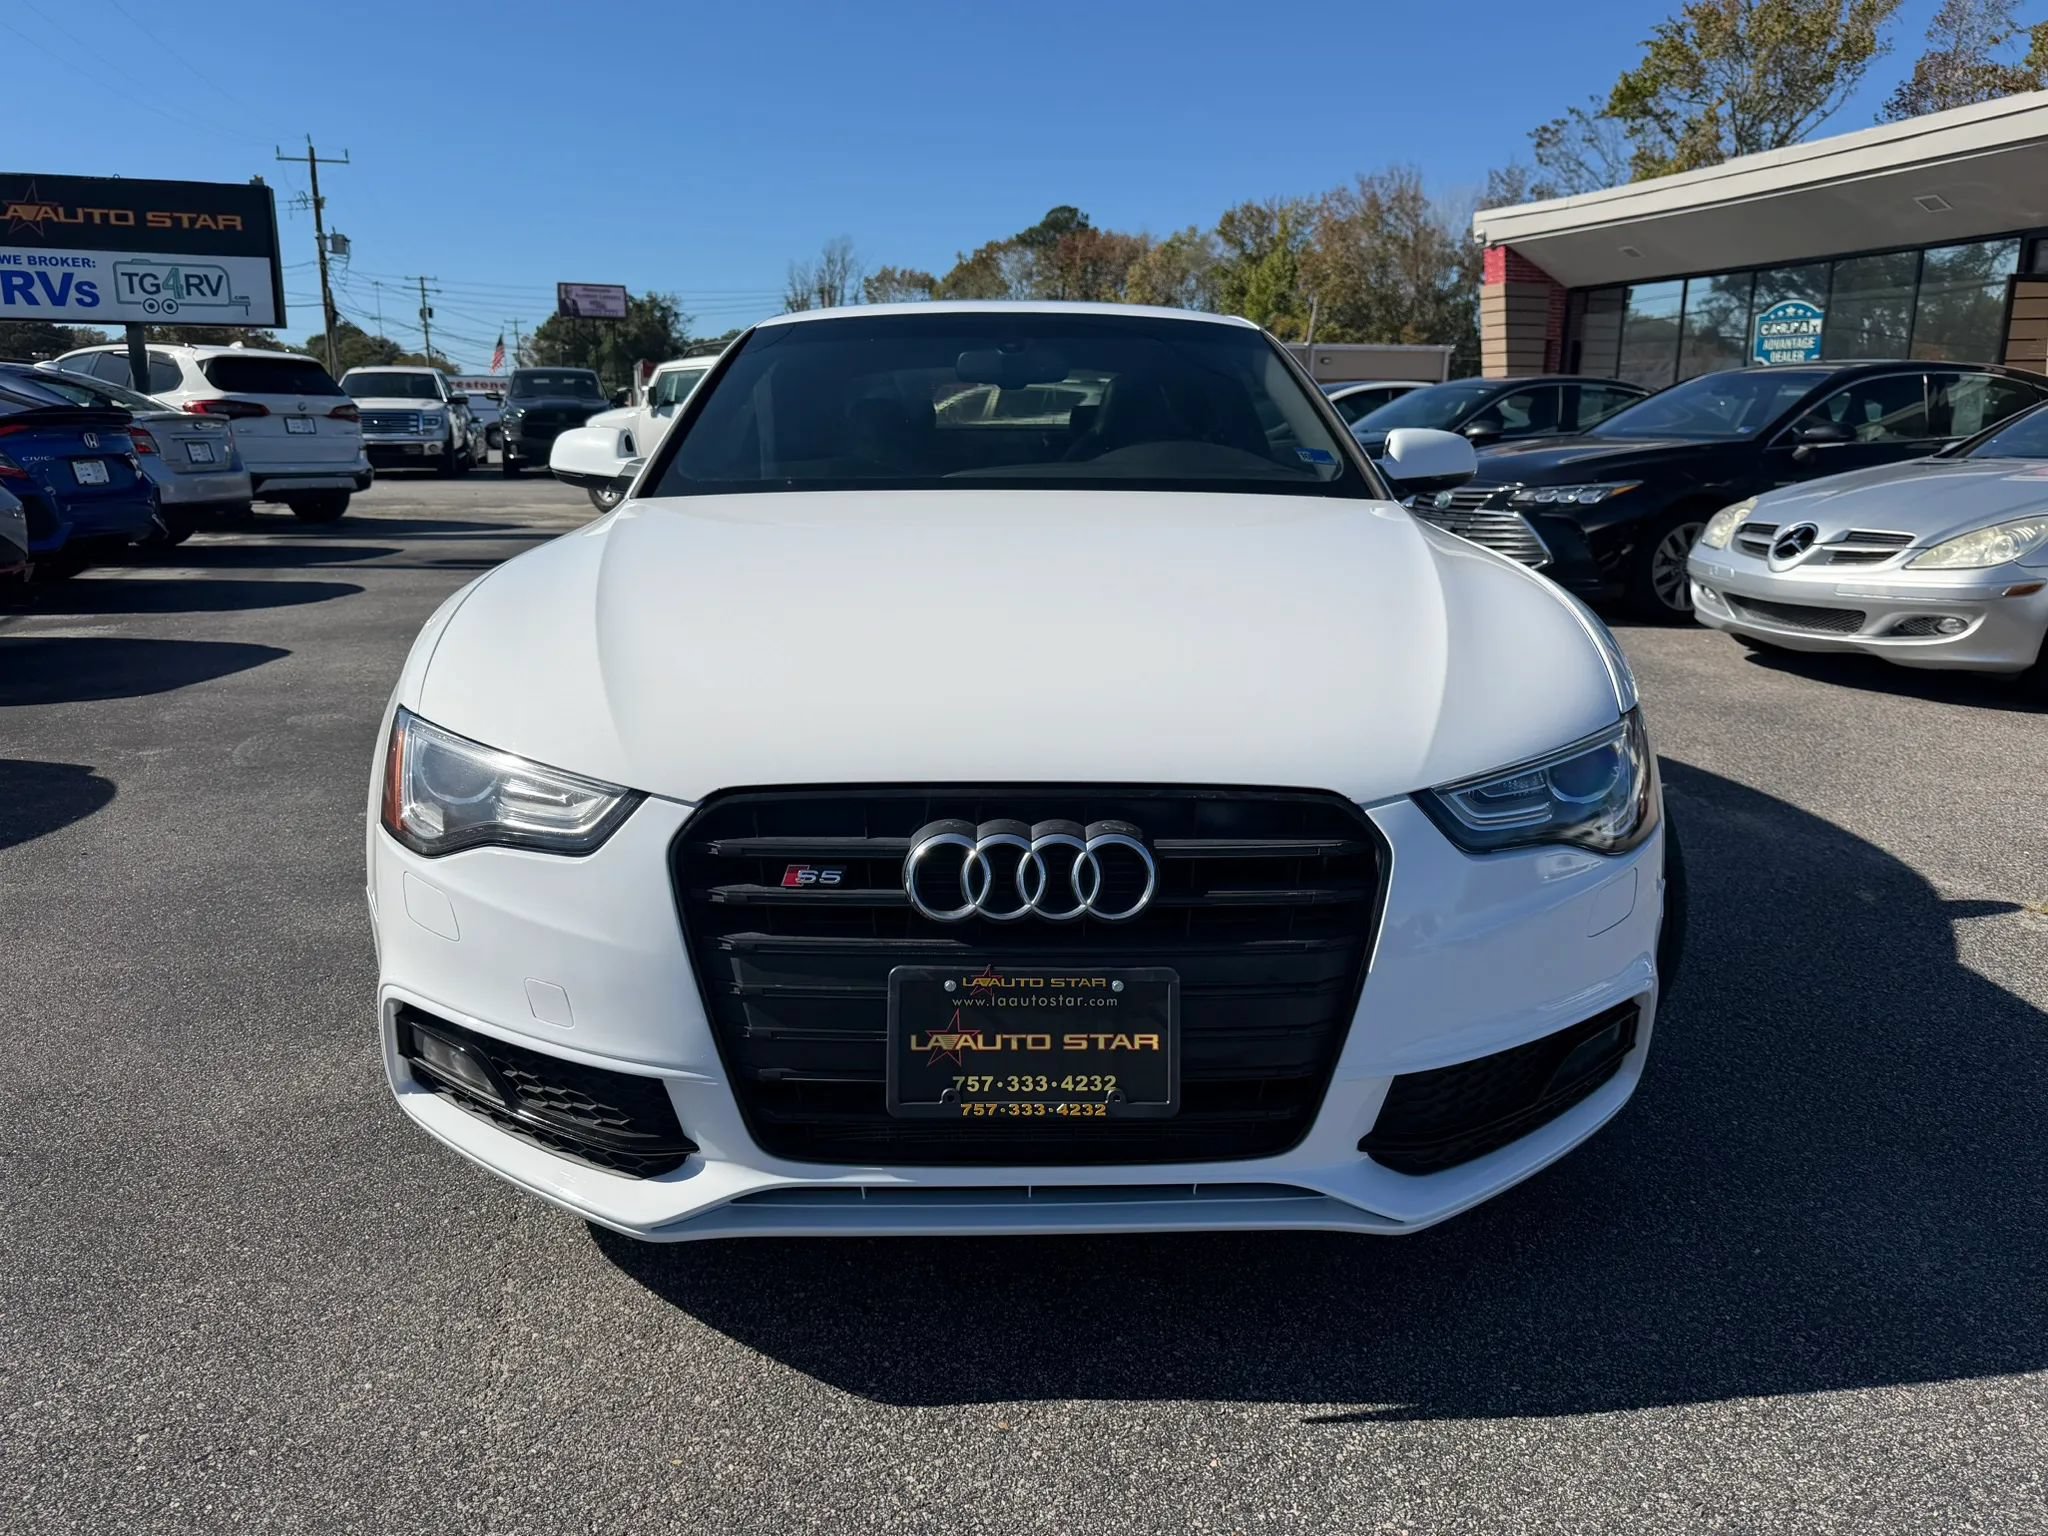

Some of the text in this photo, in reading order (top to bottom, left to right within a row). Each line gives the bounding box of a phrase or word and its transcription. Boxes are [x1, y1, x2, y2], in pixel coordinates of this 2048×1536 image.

[145, 211, 244, 232] STAR
[27, 255, 96, 268] BROKER:
[0, 270, 100, 307] RVs
[1760, 319, 1823, 336] CARFAX
[1762, 337, 1816, 351] ADVANTAGE
[1769, 350, 1805, 363] DEALER
[795, 869, 842, 884] S5
[1050, 978, 1107, 988] STAR
[952, 993, 1119, 1007] www.laautostar.com
[1062, 1034, 1159, 1051] STAR
